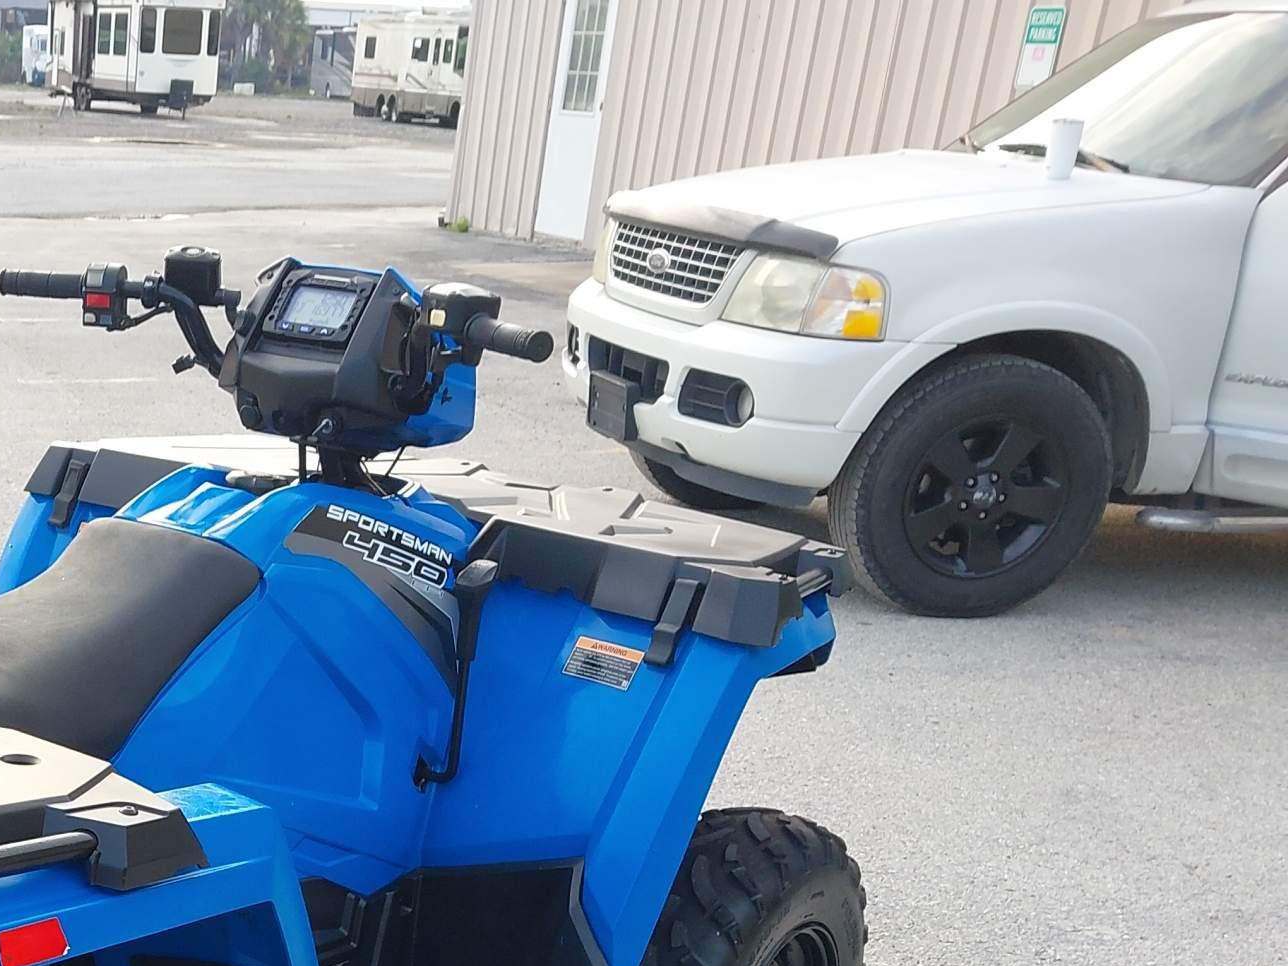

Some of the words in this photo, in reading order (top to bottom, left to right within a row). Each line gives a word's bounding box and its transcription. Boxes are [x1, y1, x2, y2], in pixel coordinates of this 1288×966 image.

[1031, 11, 1062, 26] RESERVED
[1028, 27, 1058, 41] PARKING
[327, 504, 452, 565] SPORTSMAN
[343, 530, 448, 589] 450
[598, 643, 628, 657] WARNING
